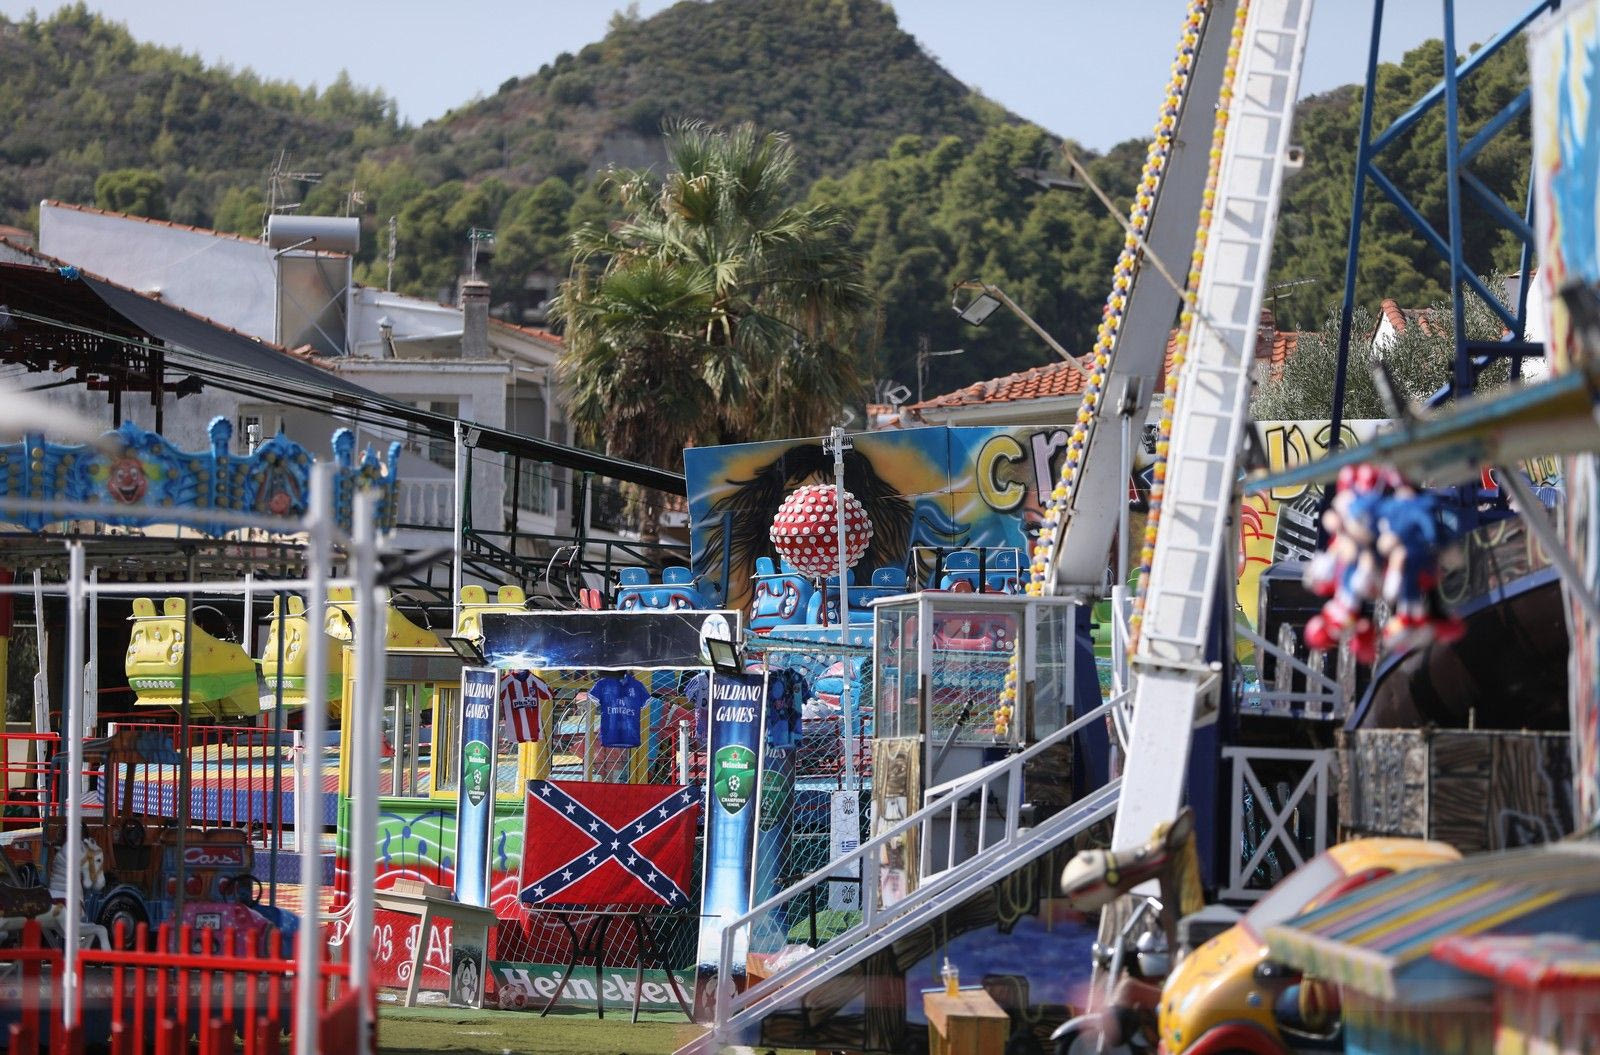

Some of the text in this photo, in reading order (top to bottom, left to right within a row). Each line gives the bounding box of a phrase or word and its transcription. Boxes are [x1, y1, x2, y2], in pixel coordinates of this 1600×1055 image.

[465, 682, 494, 699] VALDANO
[713, 684, 761, 701] VALDANO
[465, 704, 490, 720] GAMES
[716, 706, 756, 723] GAMES
[722, 760, 749, 770] Heineken
[184, 847, 241, 864] Cars
